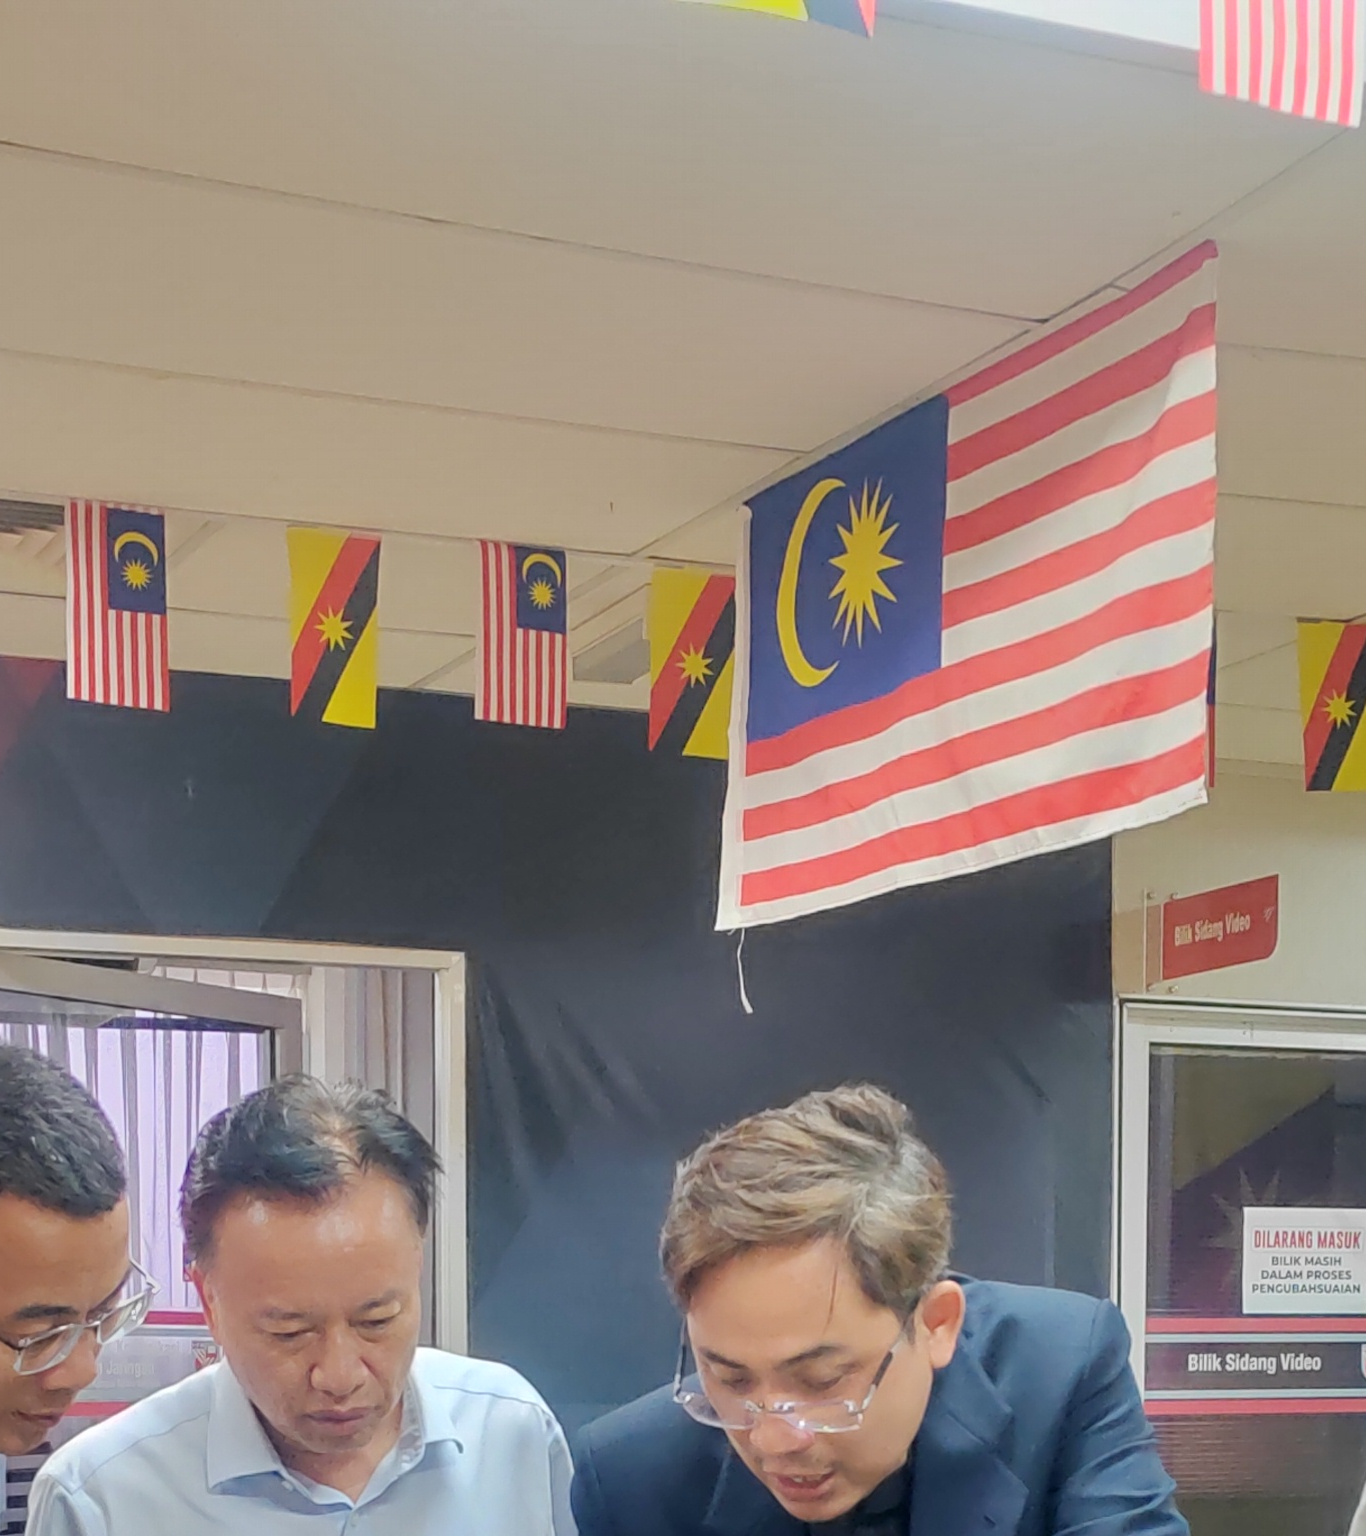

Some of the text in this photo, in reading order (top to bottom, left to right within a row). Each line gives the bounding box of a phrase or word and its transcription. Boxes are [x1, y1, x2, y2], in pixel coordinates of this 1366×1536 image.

[1195, 919, 1223, 942] Sidang
[1225, 911, 1251, 934] Video
[1254, 1229, 1362, 1249] DILARANG MASUK
[1271, 1256, 1342, 1266] BILIK MASIH
[1261, 1270, 1352, 1280] DALAM PROSES
[1252, 1283, 1361, 1294] PENGUBAHSUAIAN
[1187, 1353, 1322, 1375] Bilik Sidang Video
